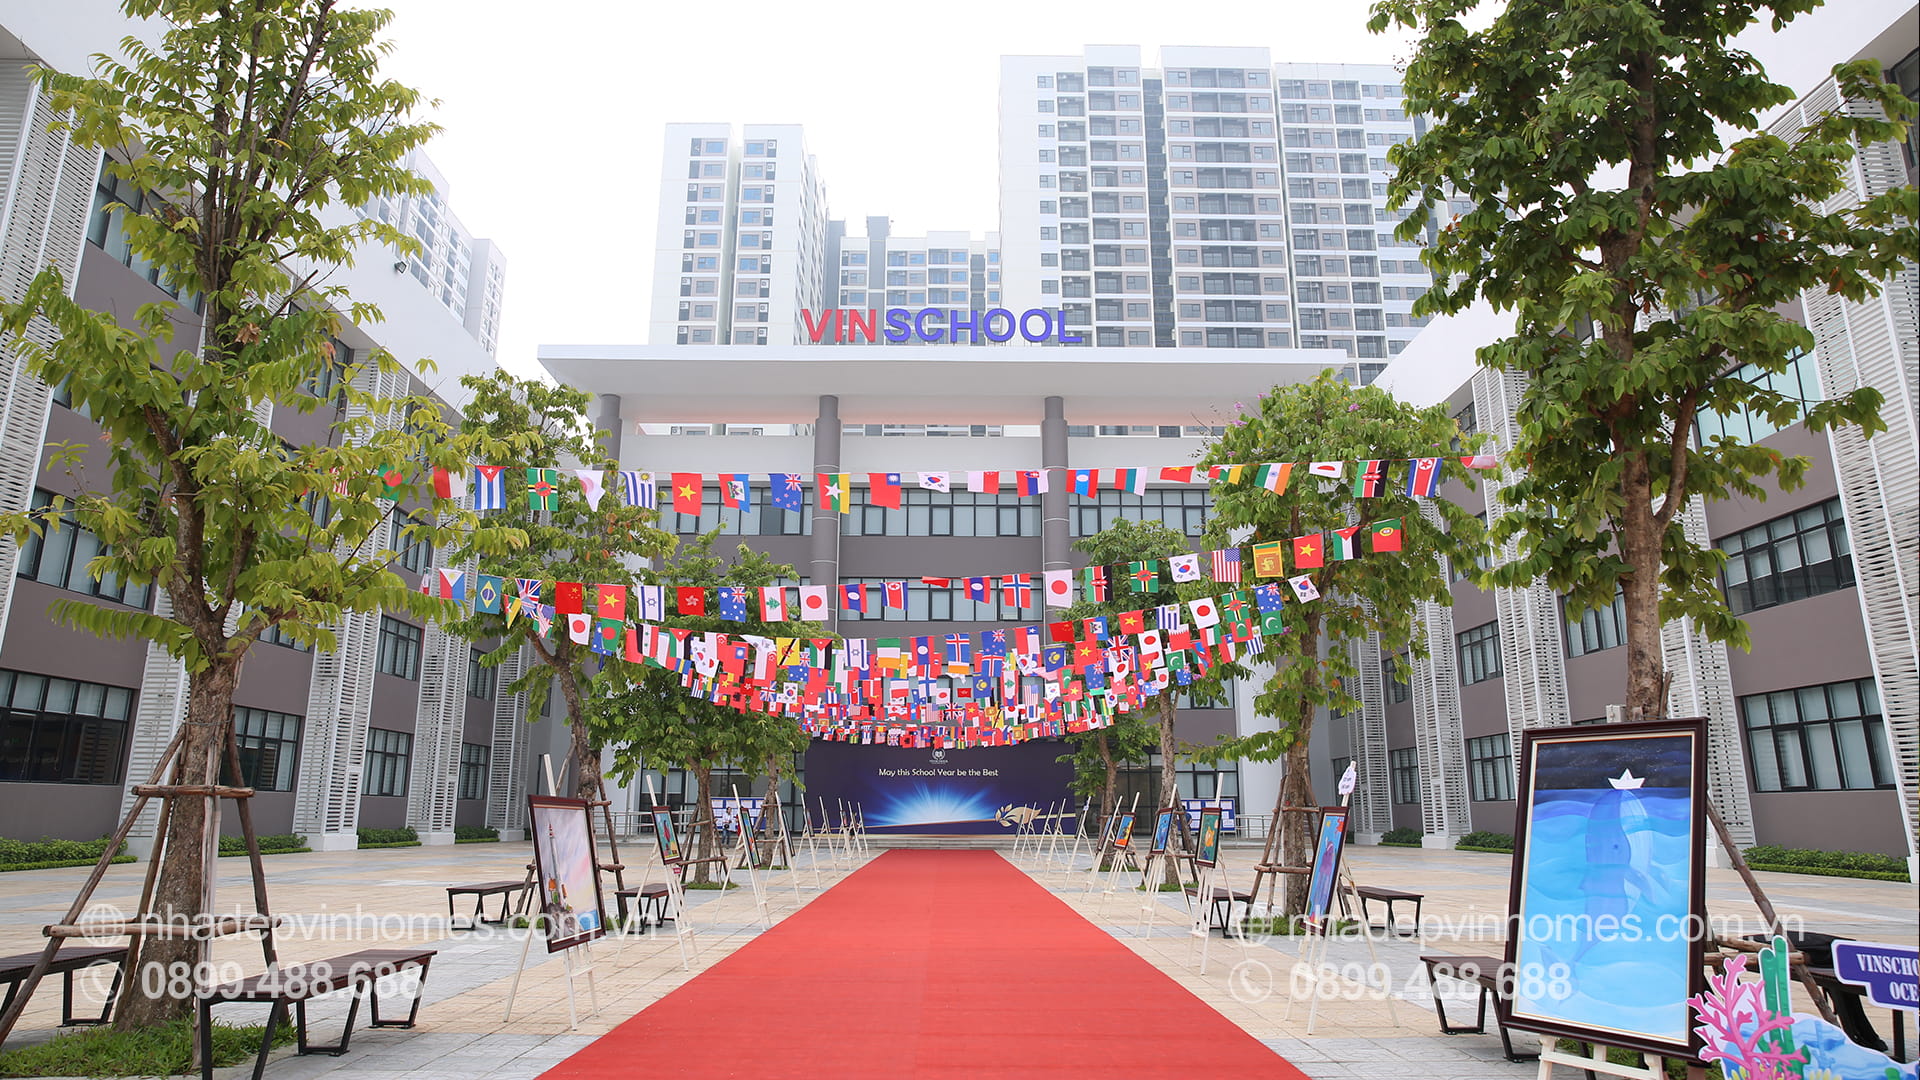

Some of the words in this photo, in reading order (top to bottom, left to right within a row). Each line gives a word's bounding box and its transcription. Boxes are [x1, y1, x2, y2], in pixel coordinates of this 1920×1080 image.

[801, 308, 1082, 343] VINSCHOOL
[878, 768, 896, 777] May
[897, 768, 910, 776] this
[912, 768, 936, 776] School
[938, 768, 955, 776] Year
[957, 768, 967, 776] be
[968, 768, 980, 776] the
[983, 768, 998, 776] Best
